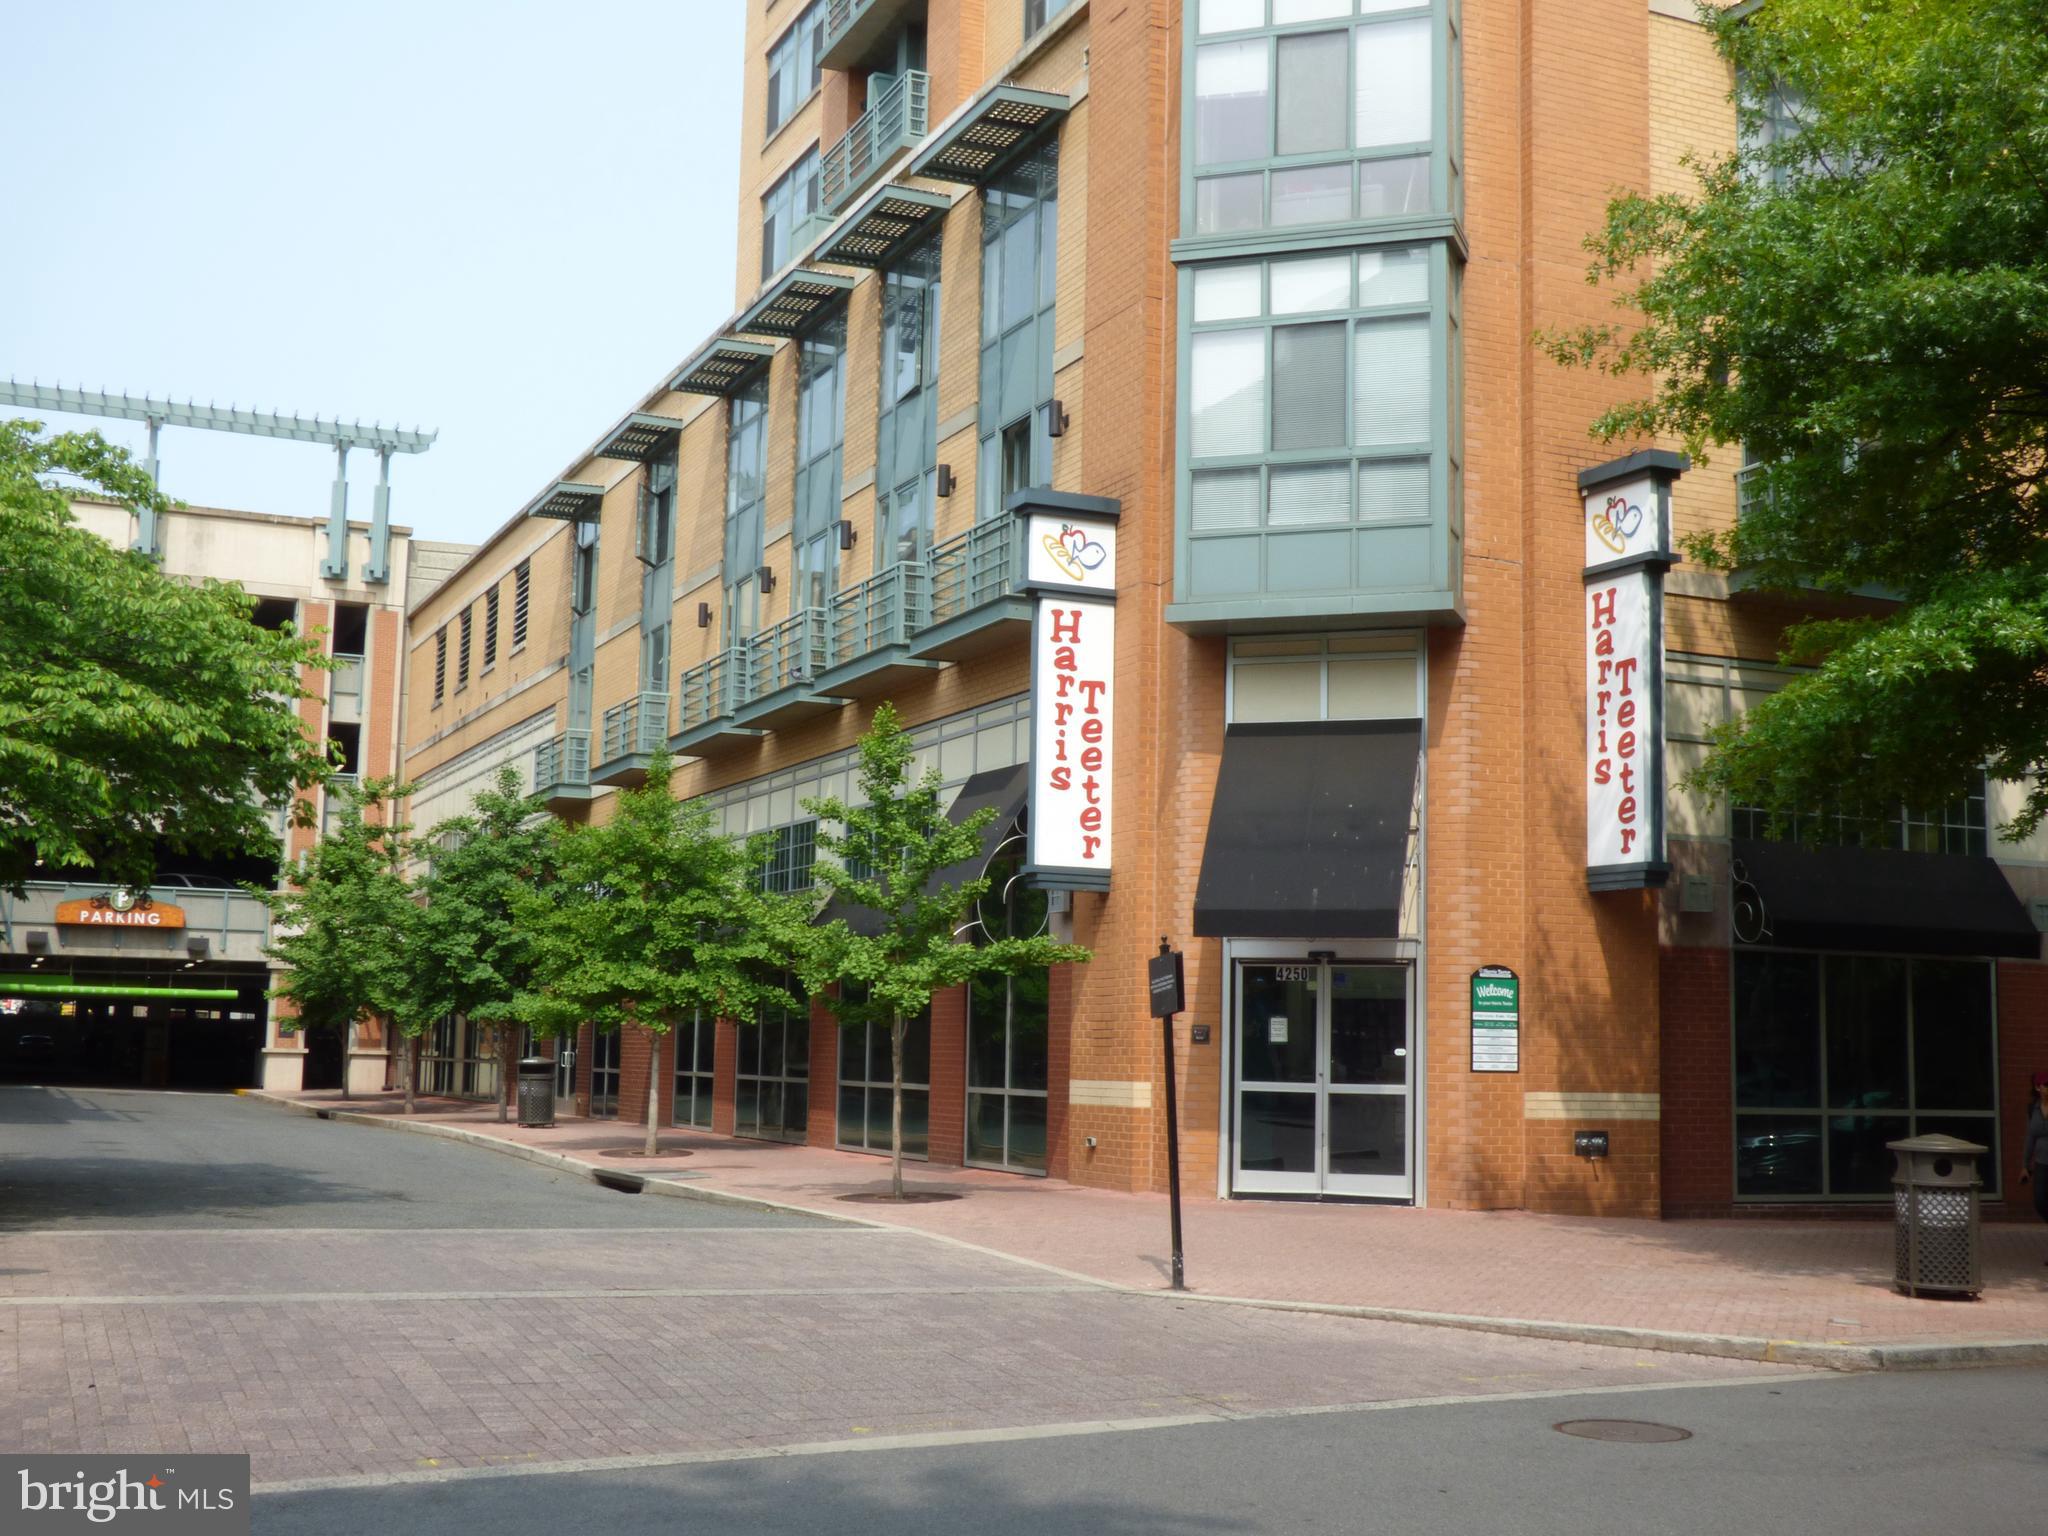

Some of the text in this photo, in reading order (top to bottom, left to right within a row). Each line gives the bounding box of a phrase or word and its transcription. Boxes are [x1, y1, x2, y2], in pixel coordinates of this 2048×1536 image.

[1592, 588, 1638, 854] Harris Teeter
[1051, 609, 1105, 860] Harris Teeter
[117, 891, 129, 907] P
[80, 910, 161, 925] PARKING
[1277, 967, 1308, 981] 4250
[1476, 984, 1514, 998] Welcome
